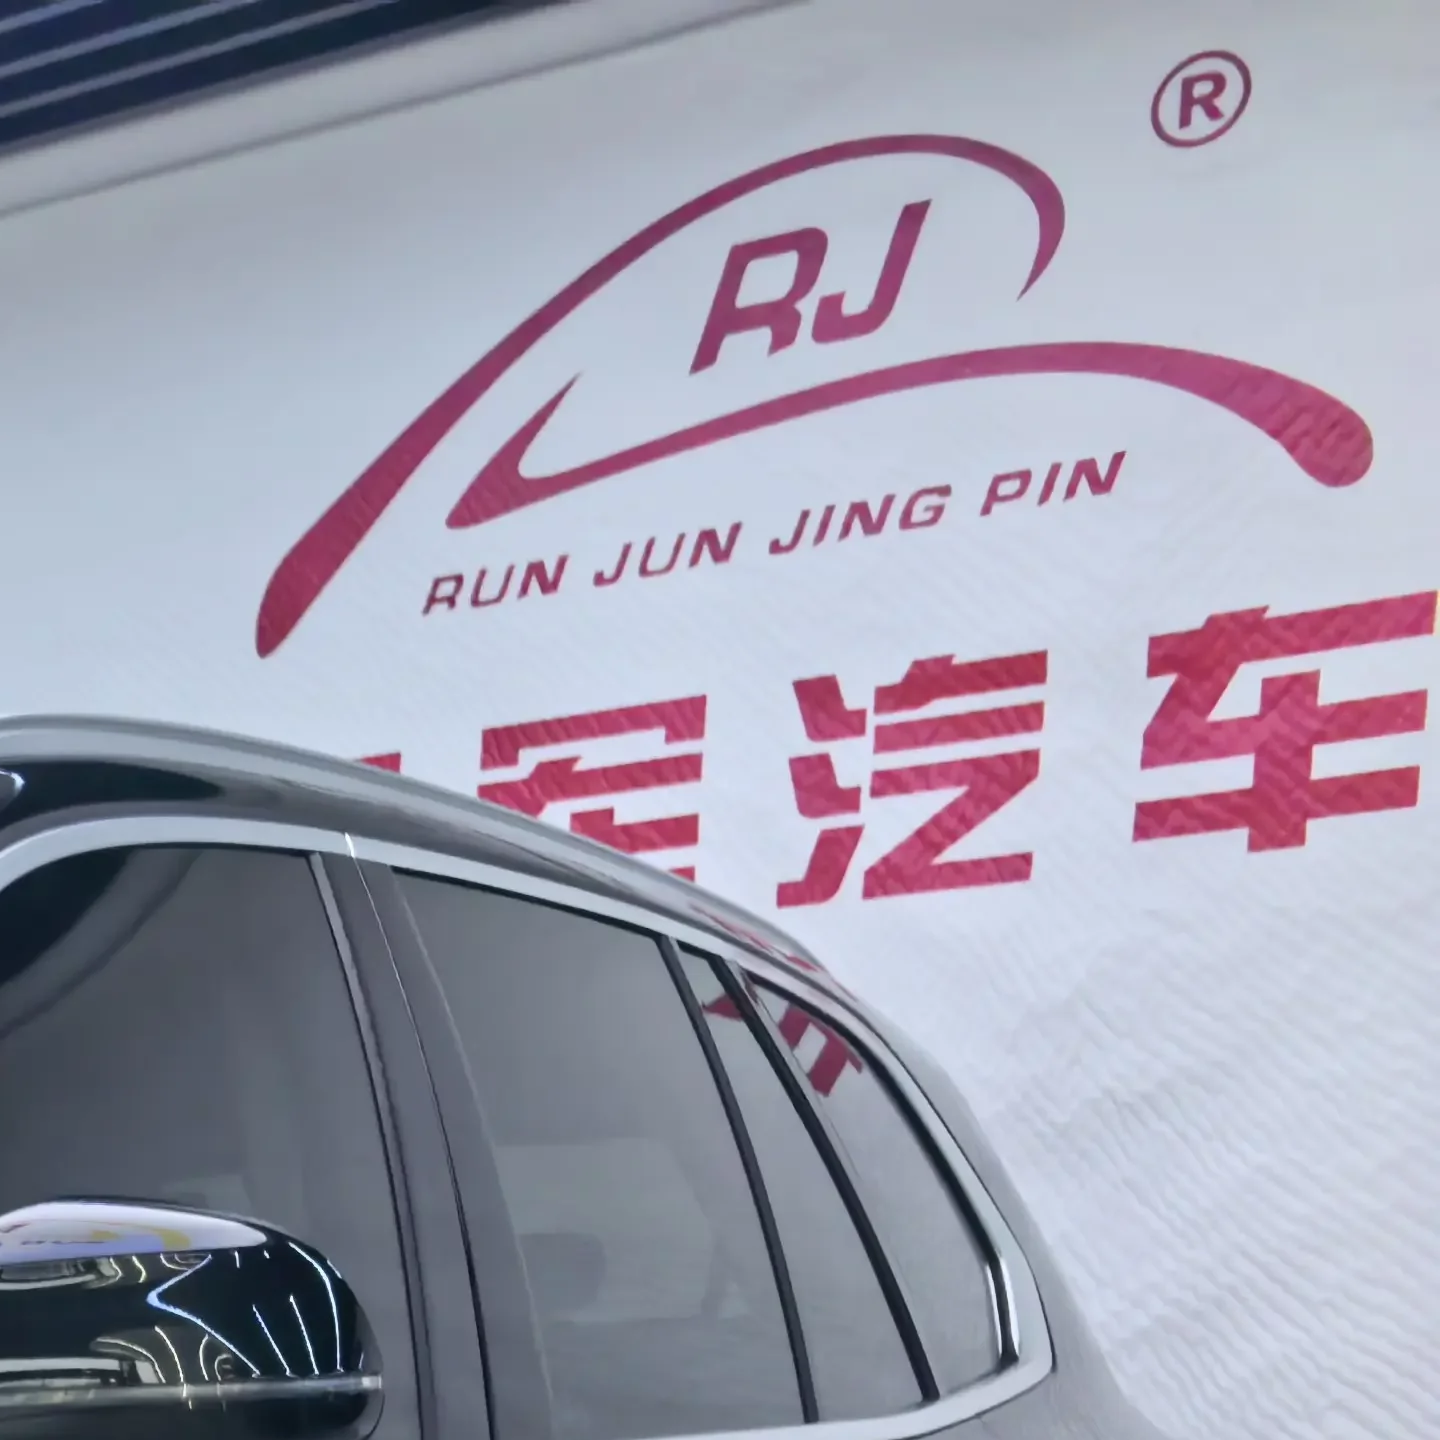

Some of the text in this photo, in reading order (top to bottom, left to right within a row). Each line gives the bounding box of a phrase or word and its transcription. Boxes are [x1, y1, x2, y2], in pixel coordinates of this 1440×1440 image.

[688, 198, 933, 376] RJ
[421, 450, 1127, 616] RUN JUN JING PIN
[358, 590, 1439, 908] 军汽车
